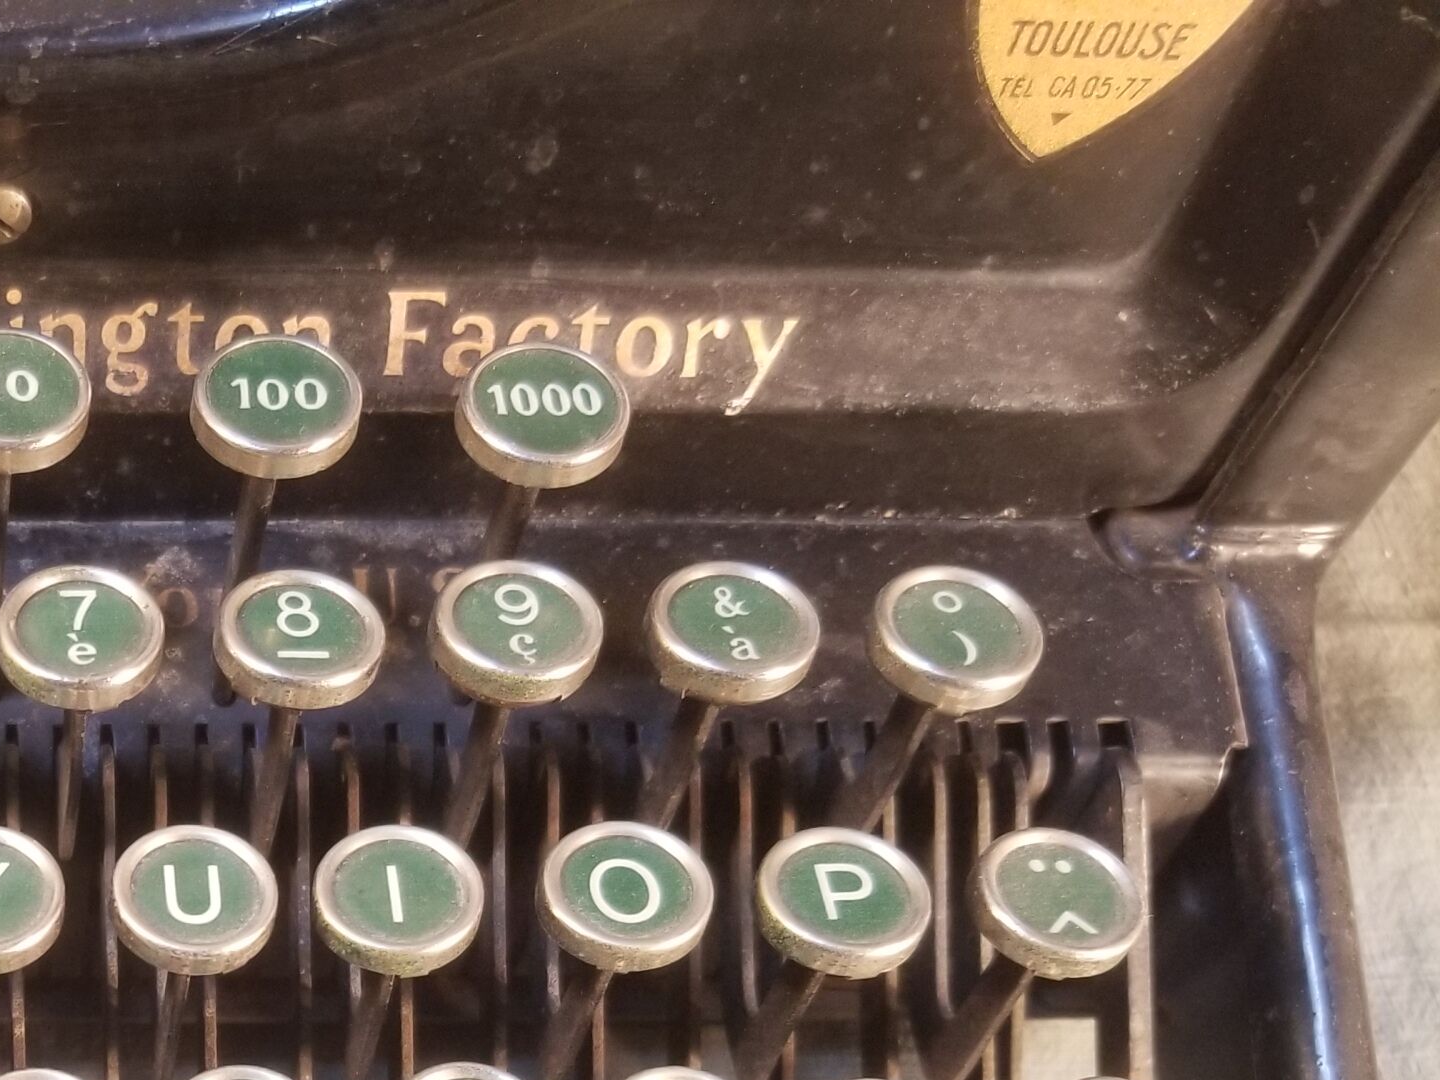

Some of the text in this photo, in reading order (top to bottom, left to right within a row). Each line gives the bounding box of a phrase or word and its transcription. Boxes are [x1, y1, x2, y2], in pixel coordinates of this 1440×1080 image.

[1006, 19, 1198, 61] TOULOUSE
[230, 377, 328, 411] 100
[486, 382, 602, 416] 1000
[58, 588, 97, 631] 7
[276, 590, 320, 637] 8
[494, 583, 540, 626] 9
[714, 586, 750, 618] &
[163, 864, 222, 925] U
[386, 865, 404, 923] I
[589, 858, 662, 924] O
[814, 862, 873, 920] P
